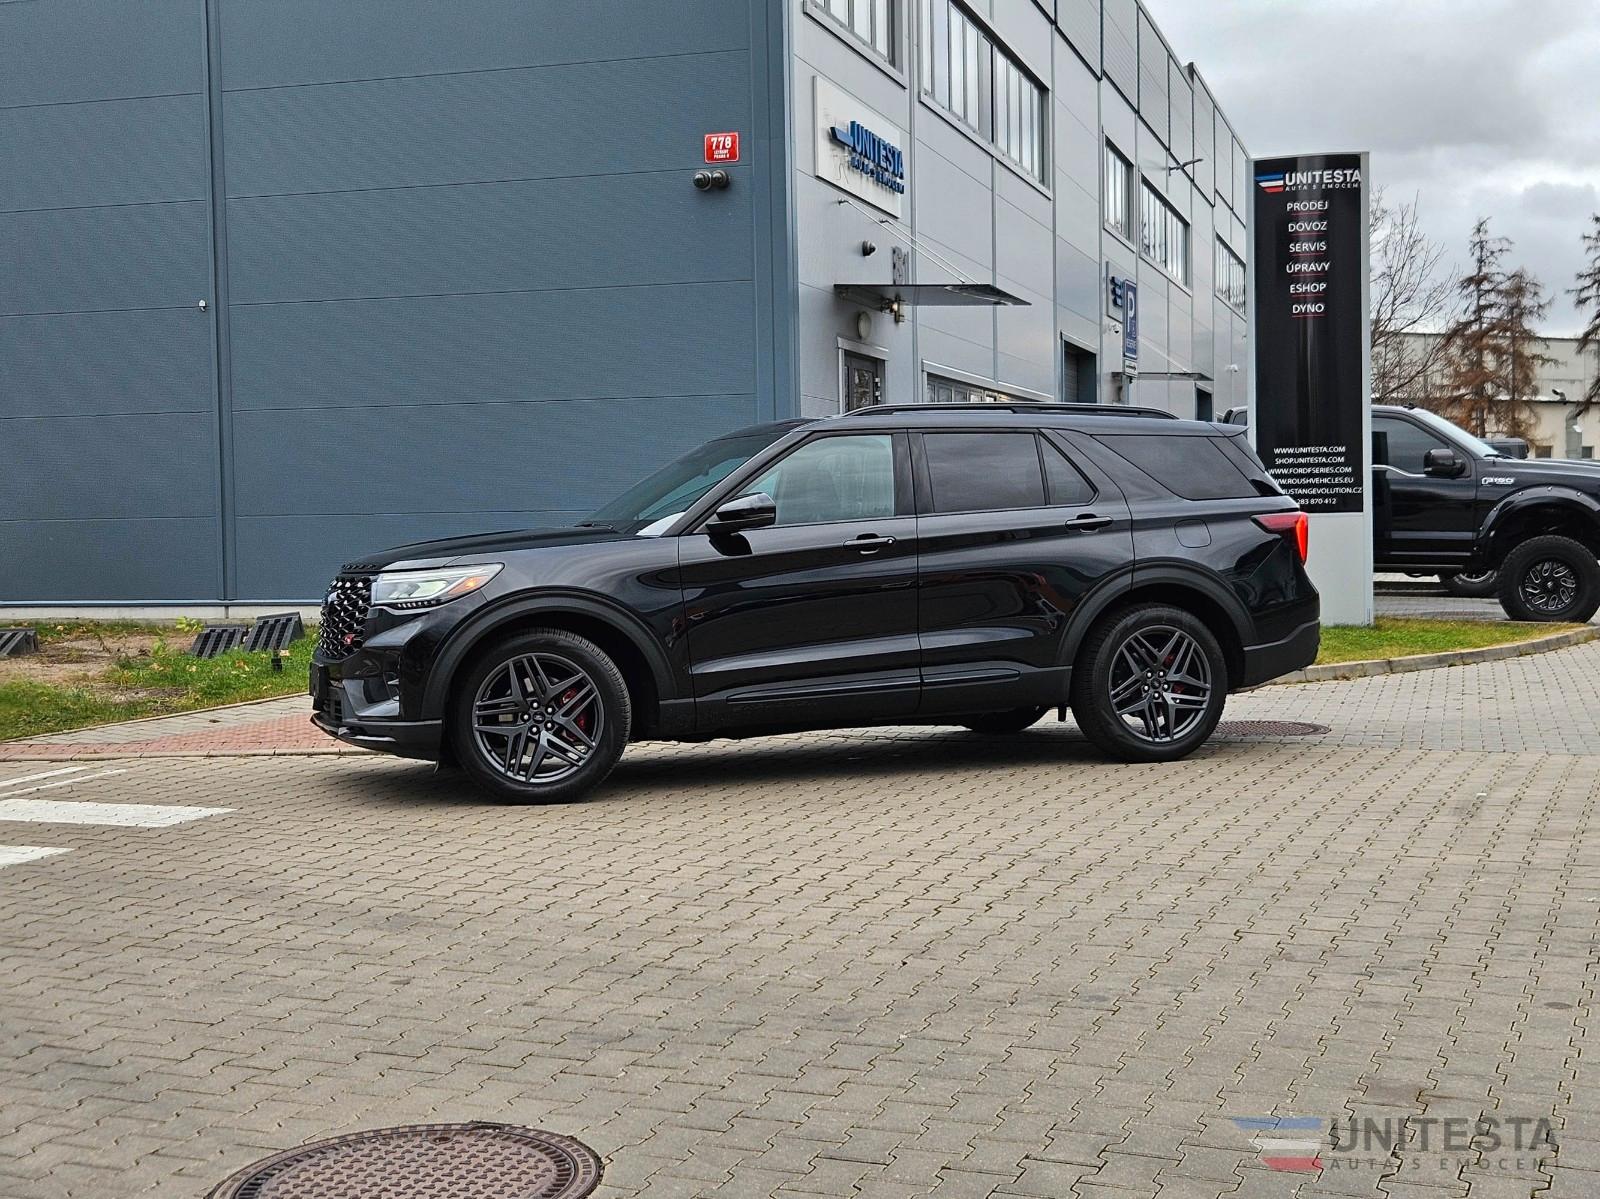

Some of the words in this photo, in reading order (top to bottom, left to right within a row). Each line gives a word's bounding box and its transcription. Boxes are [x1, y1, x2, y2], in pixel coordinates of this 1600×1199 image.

[711, 136, 732, 150] 778
[850, 121, 904, 180] UNITESTA
[1285, 169, 1361, 186] UNITESTA
[1286, 201, 1328, 212] PRODEJ
[1288, 221, 1328, 232] DOVOZ
[1289, 241, 1327, 253] SERVIS
[1286, 261, 1330, 273] ÚPRAVY
[1290, 282, 1327, 294] ESHOP
[1127, 291, 1135, 333] P
[1292, 303, 1325, 314] DYNO
[1273, 445, 1346, 454] WWW.UNITESTA.COM
[1275, 456, 1345, 465] SHOP.UNITESTA.COM
[1268, 466, 1352, 475] WWW.FORDFSERIES.COM
[1274, 477, 1354, 485] WW.ROUSHVEHICLES.EU
